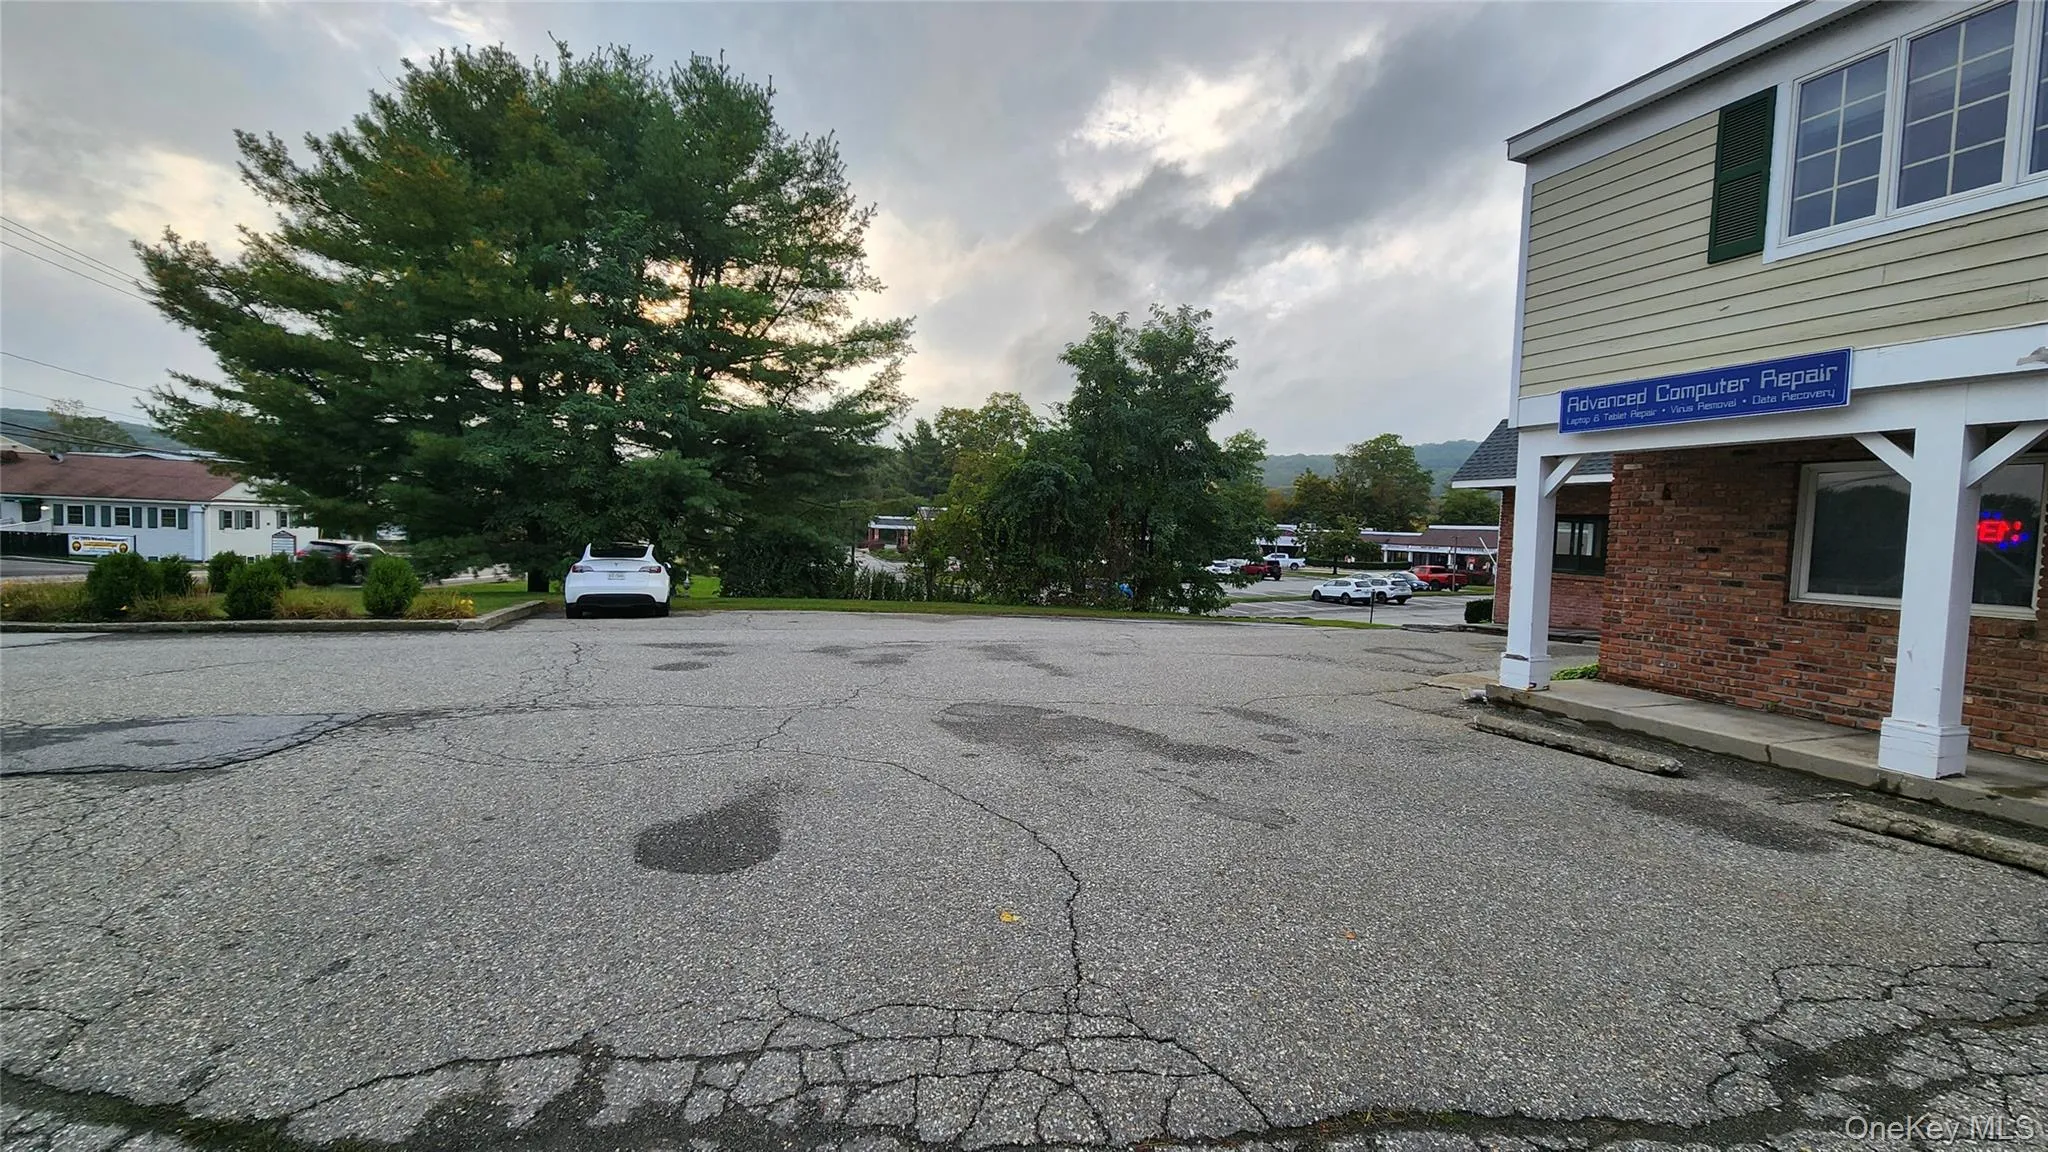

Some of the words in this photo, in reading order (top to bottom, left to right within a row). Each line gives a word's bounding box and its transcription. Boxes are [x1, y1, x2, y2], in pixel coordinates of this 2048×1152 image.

[1566, 417, 1590, 425] Laptop
[1604, 412, 1627, 421] Tablet
[1630, 408, 1657, 419] Repair
[1670, 404, 1693, 414] Virus
[1697, 398, 1737, 410] Removal
[1752, 395, 1777, 405] Data
[1781, 389, 1835, 401] Recovery
[1567, 387, 1647, 413] Advanced
[1656, 378, 1750, 402] Computer
[1760, 364, 1838, 390] Repair
